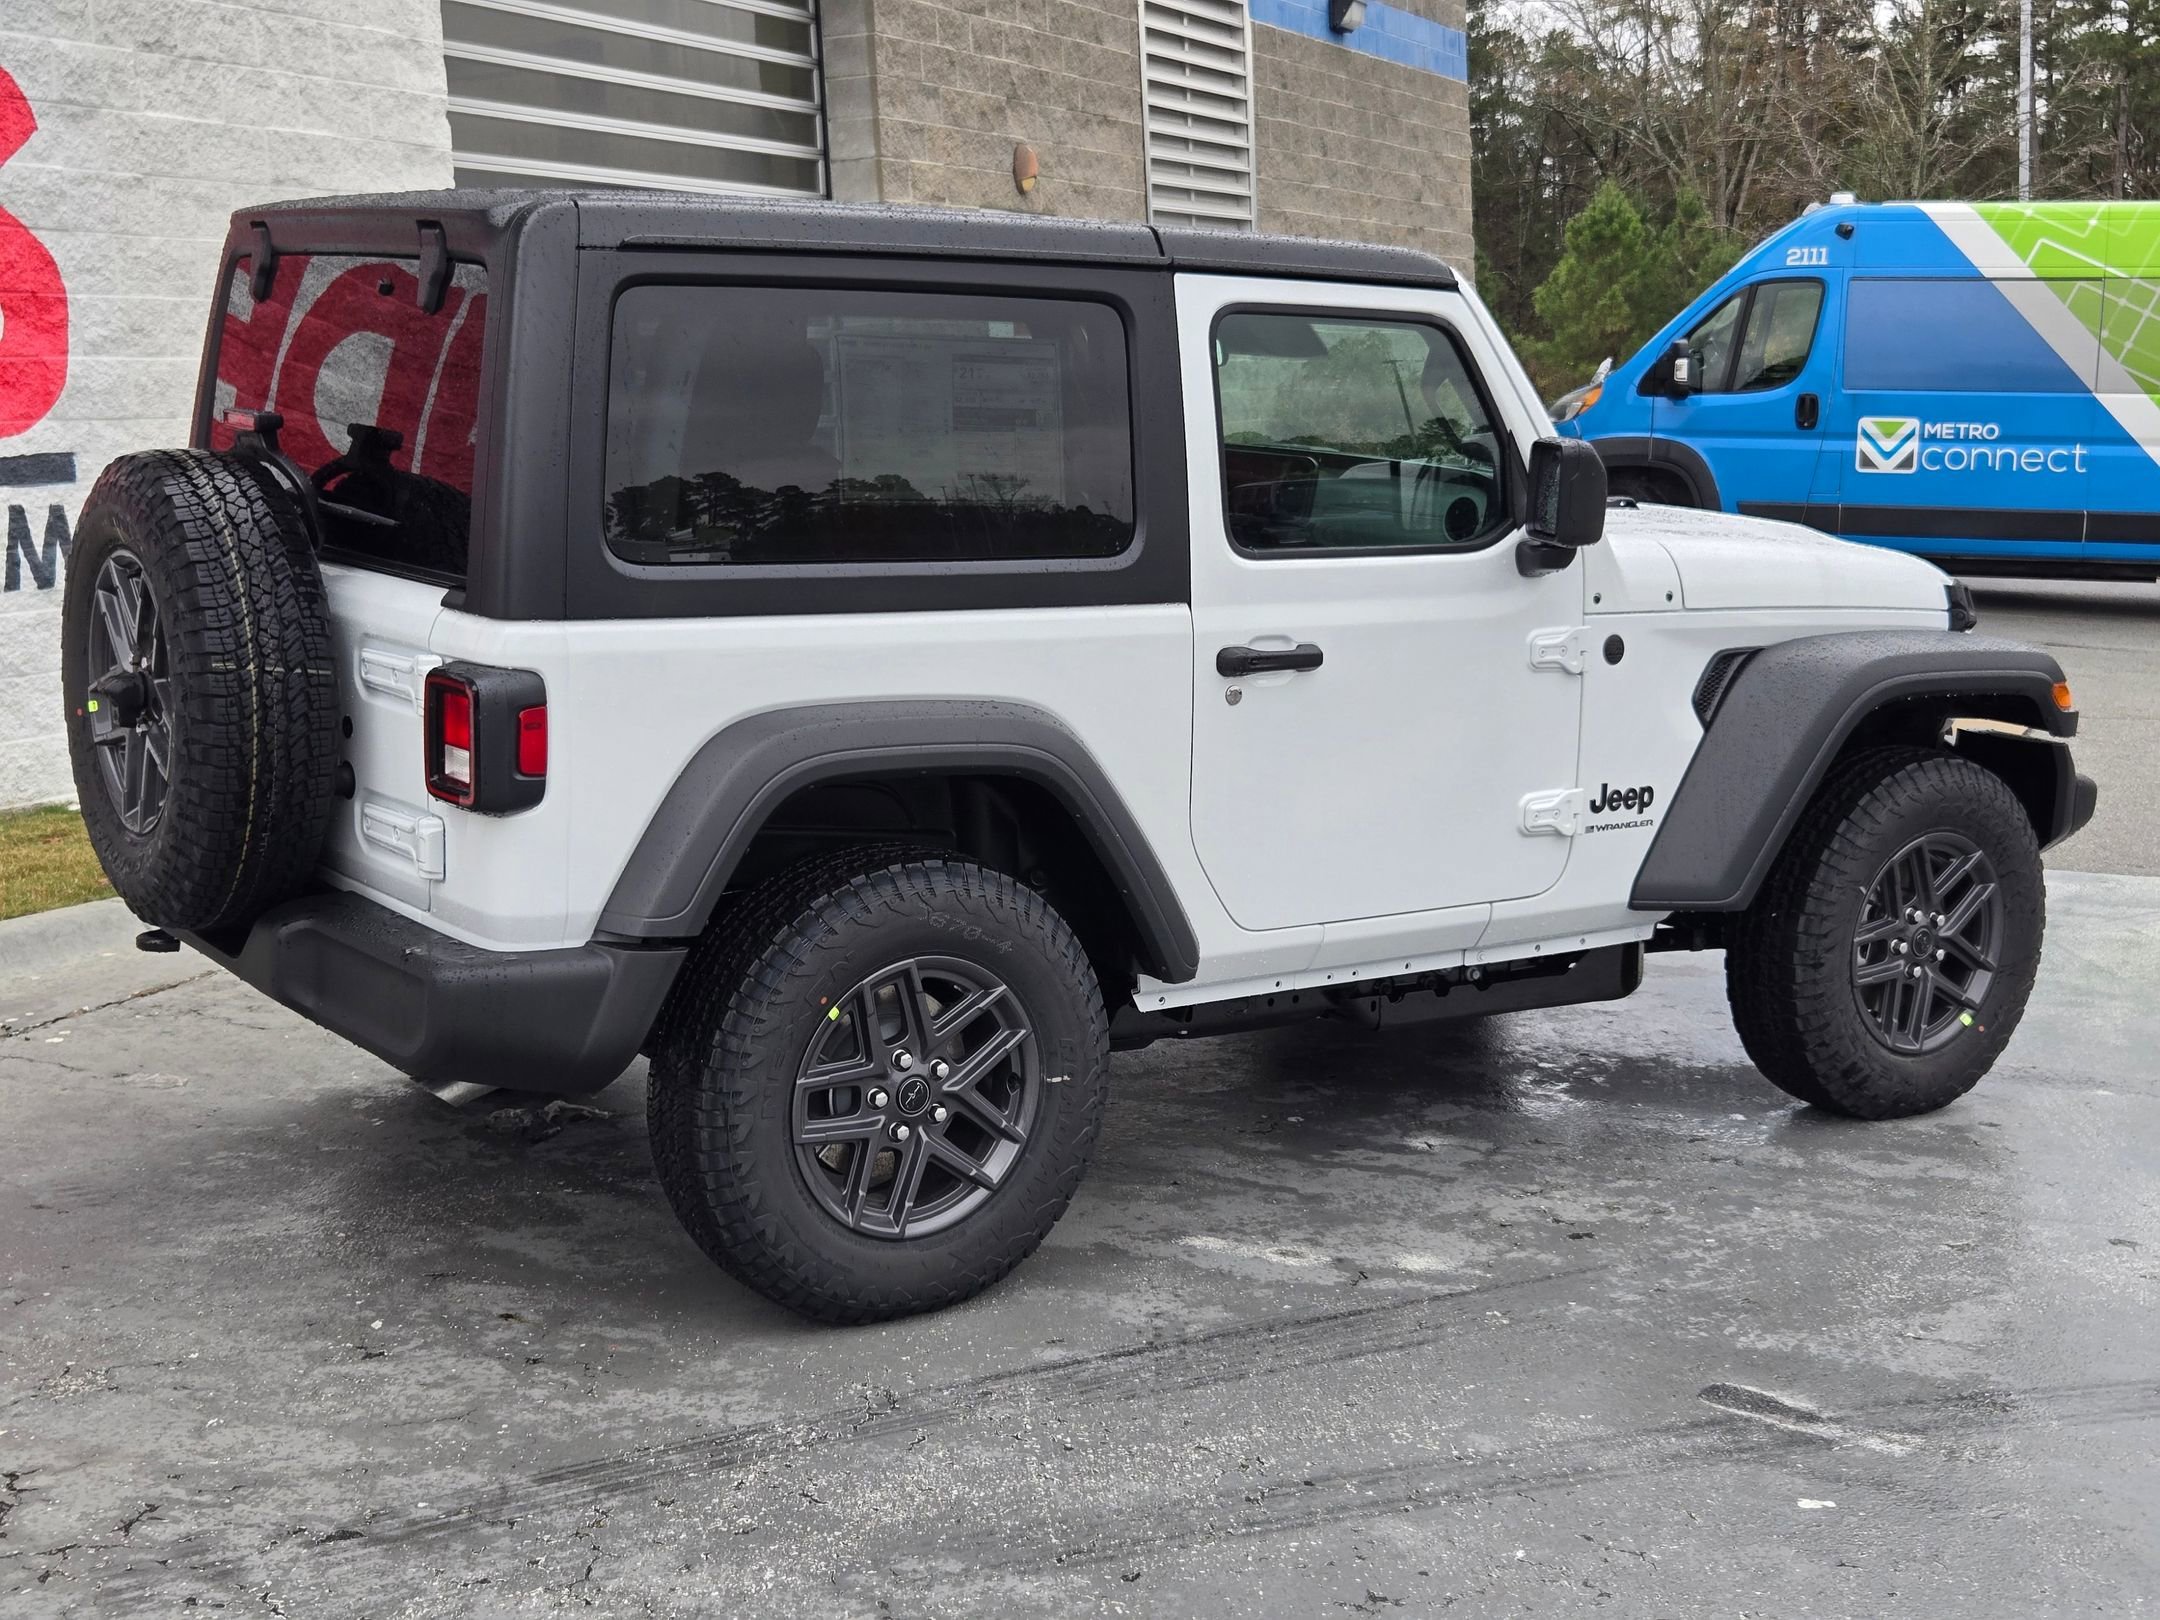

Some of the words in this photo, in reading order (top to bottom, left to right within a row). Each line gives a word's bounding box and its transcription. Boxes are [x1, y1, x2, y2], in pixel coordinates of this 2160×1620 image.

[1786, 247, 1828, 266] 2111
[1923, 423, 1999, 440] METRO
[1921, 443, 2088, 474] connect
[1589, 782, 1655, 815] Jeep
[1595, 819, 1654, 832] WRANGLER
